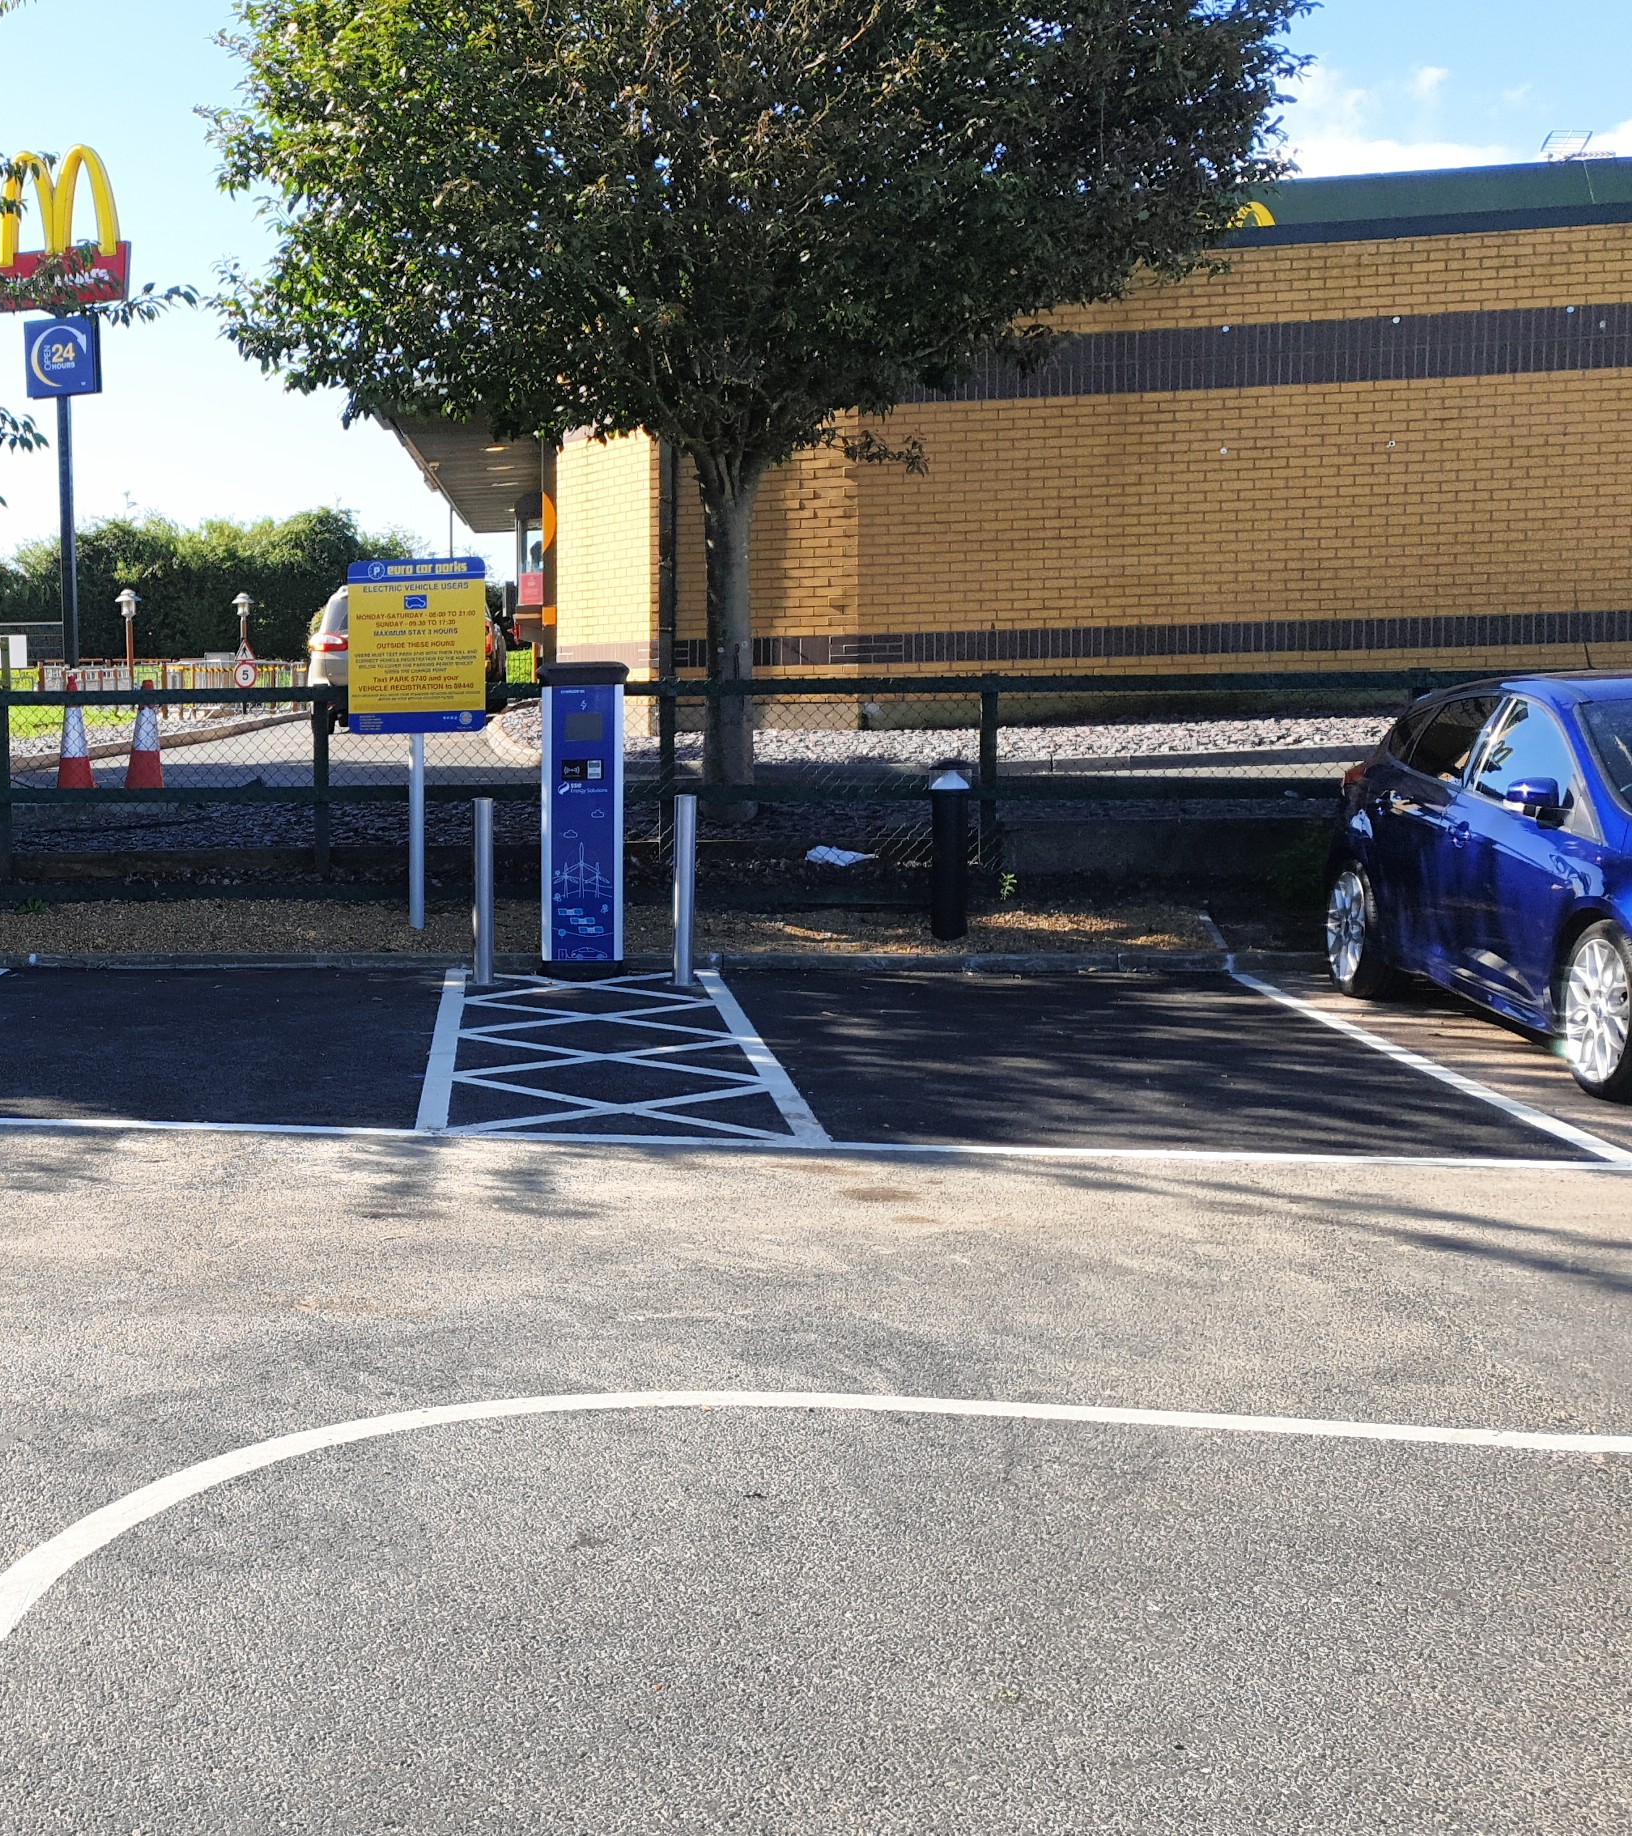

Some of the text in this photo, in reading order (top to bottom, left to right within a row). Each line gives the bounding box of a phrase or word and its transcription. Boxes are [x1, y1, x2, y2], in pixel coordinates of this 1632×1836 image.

[43, 344, 52, 371] OPEN
[51, 342, 76, 363] 24
[51, 361, 76, 371] HOURS
[387, 561, 467, 575] euro car parks
[363, 582, 469, 593] ELECTRIC VEHICLE USERS
[356, 612, 423, 620] MONDAY-SATURDAY
[375, 620, 403, 628] SUNDAY
[373, 629, 406, 637] MAXIMUM
[408, 628, 426, 636] STAY
[376, 642, 405, 650] OUTSIDE
[242, 670, 249, 681] 5
[390, 683, 443, 691] REGISTRATION
